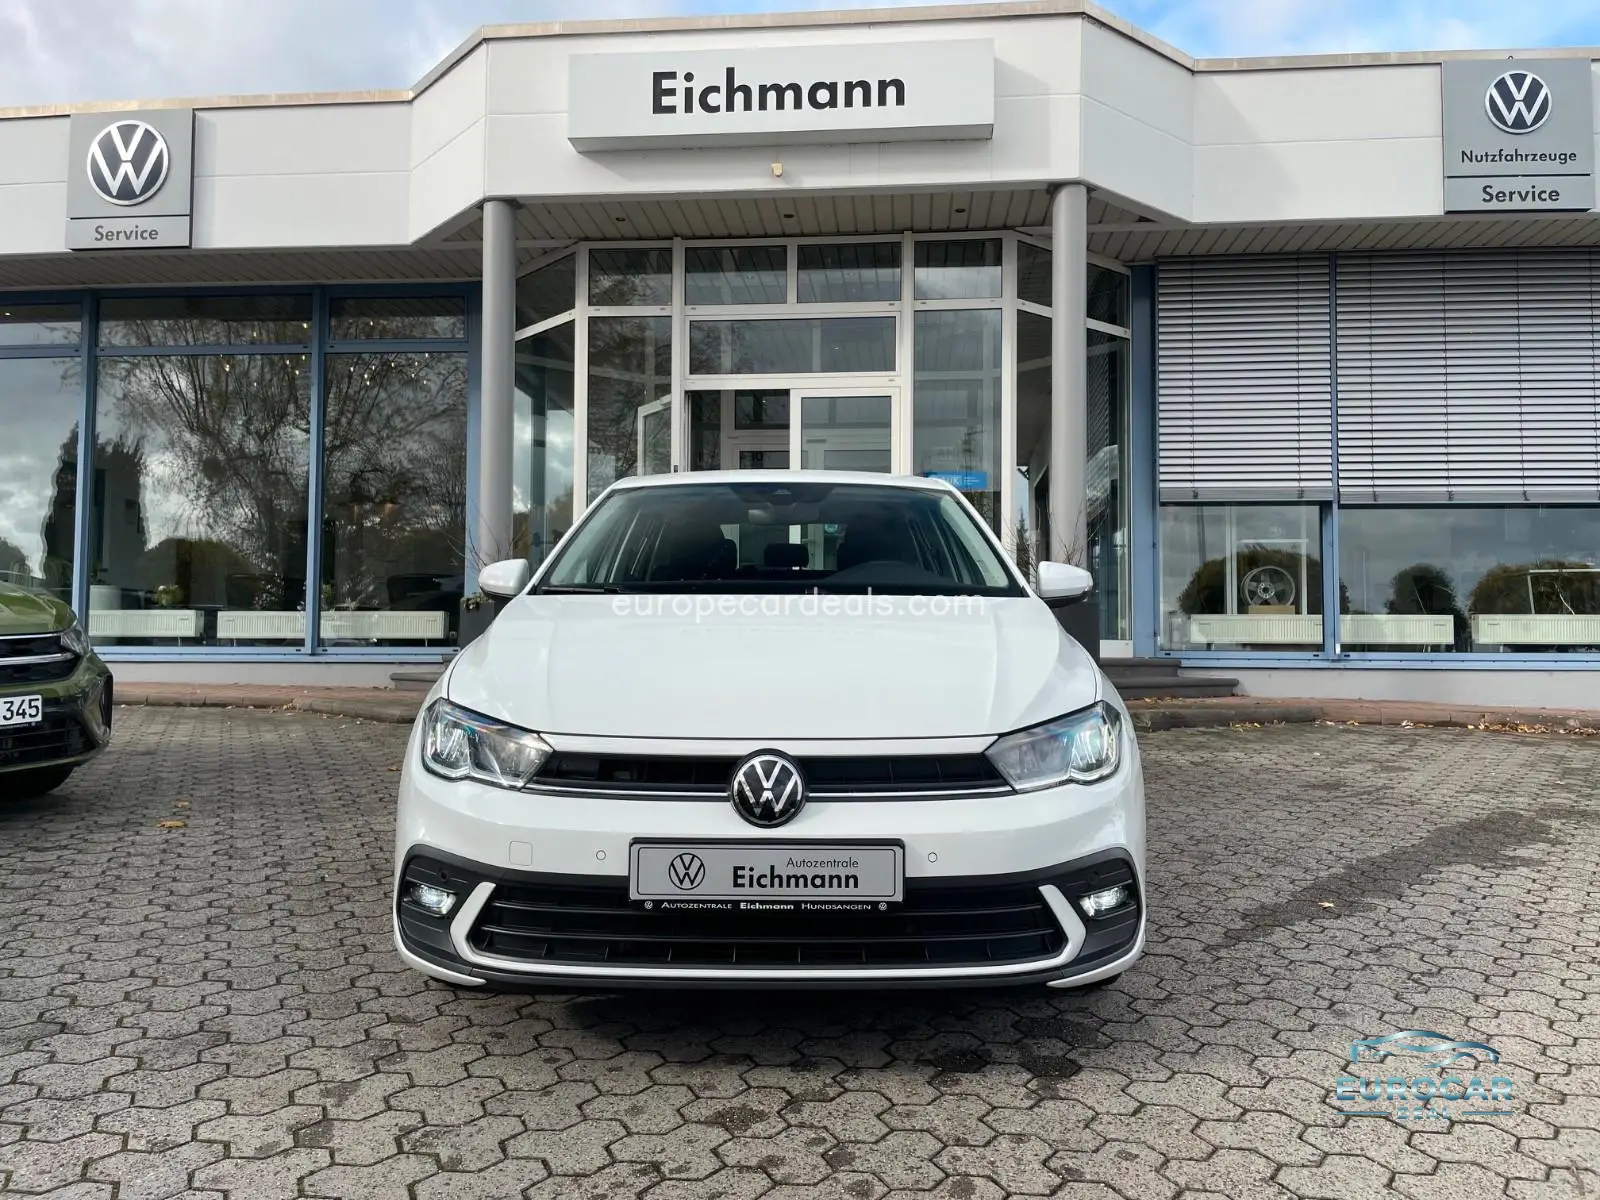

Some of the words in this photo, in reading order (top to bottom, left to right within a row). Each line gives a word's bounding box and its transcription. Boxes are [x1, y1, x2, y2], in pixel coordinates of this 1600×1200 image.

[652, 67, 905, 114] Eichmann
[1461, 149, 1577, 164] Nutzfahrzeuge
[1482, 185, 1560, 203] Service
[94, 225, 159, 241] Service
[3, 698, 40, 721] 345
[786, 857, 859, 868] Autozentrale
[732, 865, 859, 889] Eichmann
[661, 901, 732, 909] AUTOZENTRALE
[740, 902, 794, 910] Eichmann
[801, 902, 871, 910] HUNDSANGEN
